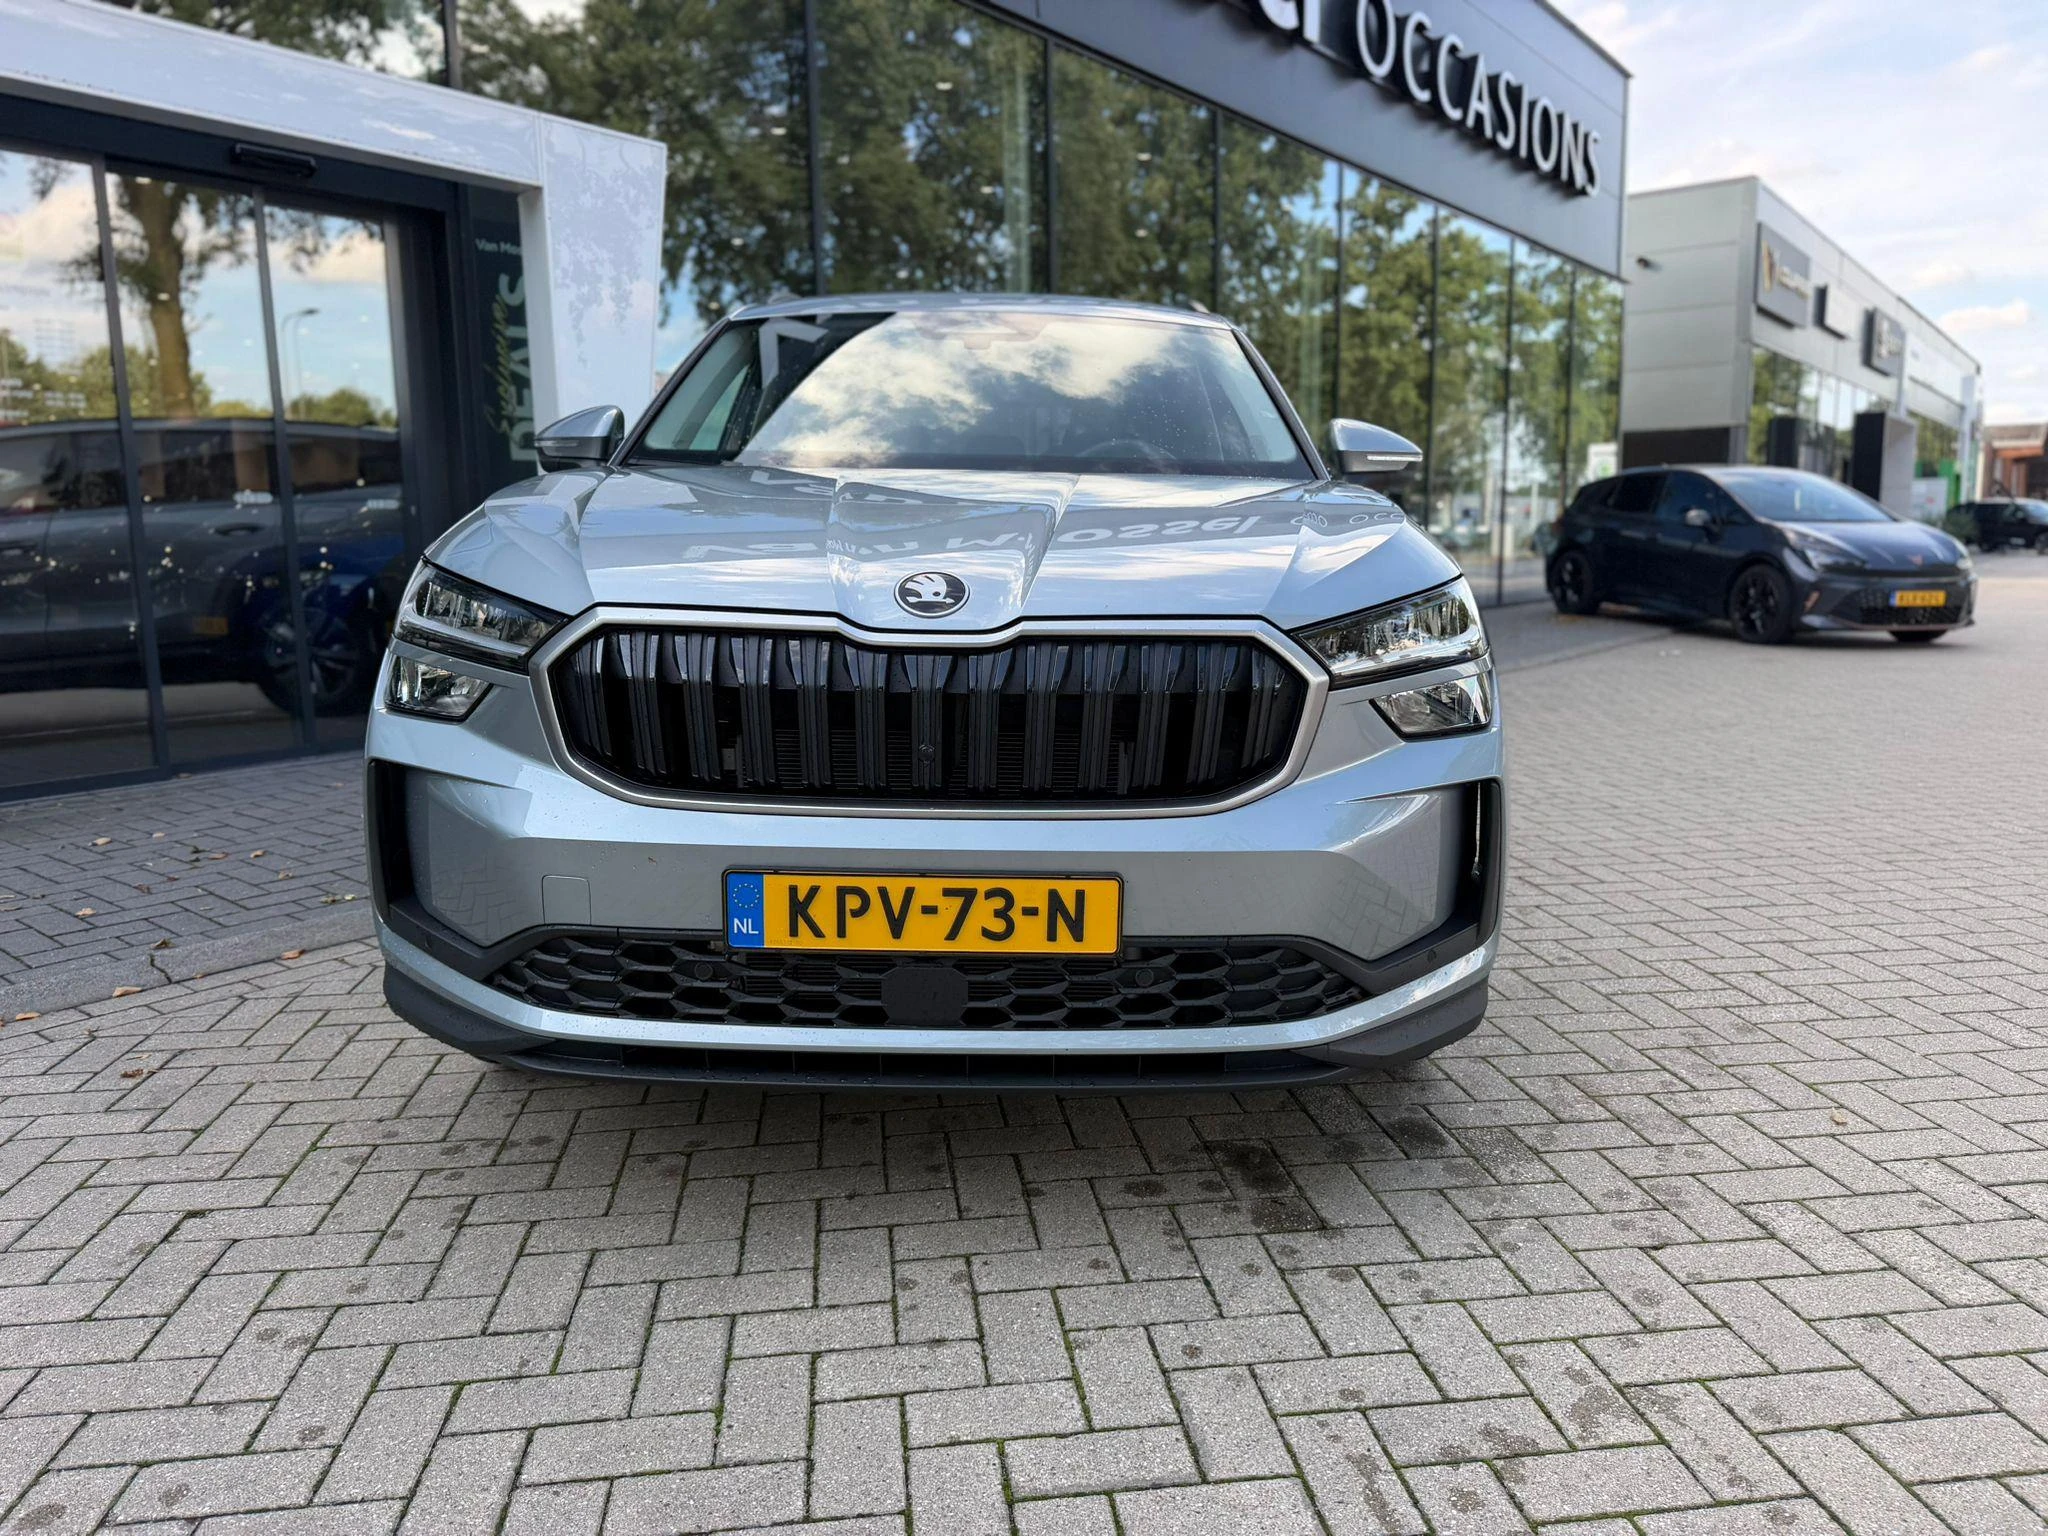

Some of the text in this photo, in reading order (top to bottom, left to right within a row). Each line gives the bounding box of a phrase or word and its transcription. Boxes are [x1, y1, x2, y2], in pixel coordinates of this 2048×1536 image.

[1356, 0, 1602, 197] OCCASIONS
[475, 238, 498, 252] Van
[733, 918, 759, 935] NL
[788, 884, 1087, 943] KPV-73-N
